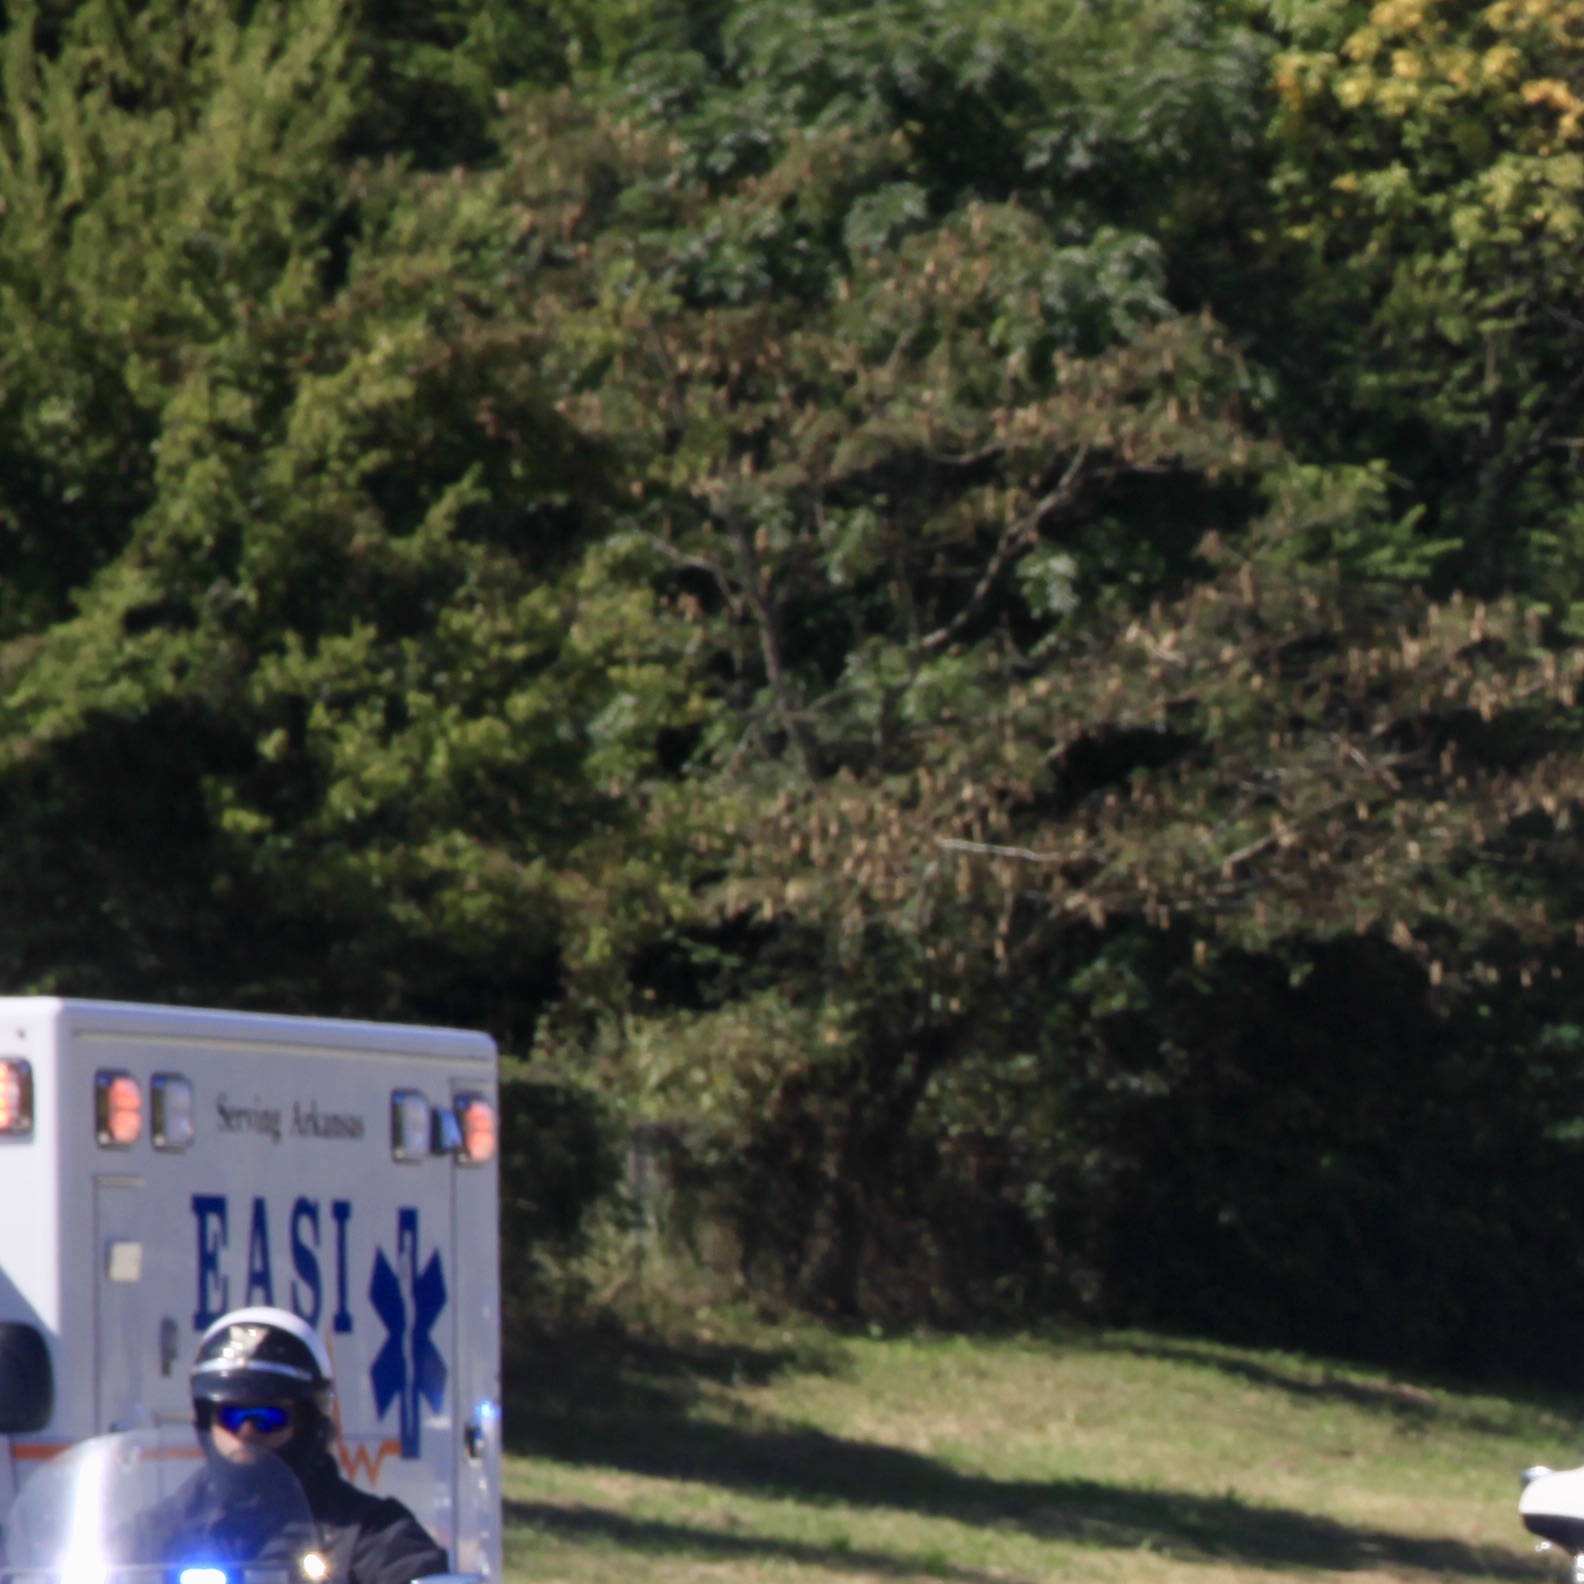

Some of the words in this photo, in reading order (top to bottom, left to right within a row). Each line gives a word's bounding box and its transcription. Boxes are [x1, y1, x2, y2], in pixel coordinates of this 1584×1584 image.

[217, 1093, 282, 1145] Serving
[291, 1099, 365, 1139] Arkansas
[191, 1193, 352, 1333] EASI
